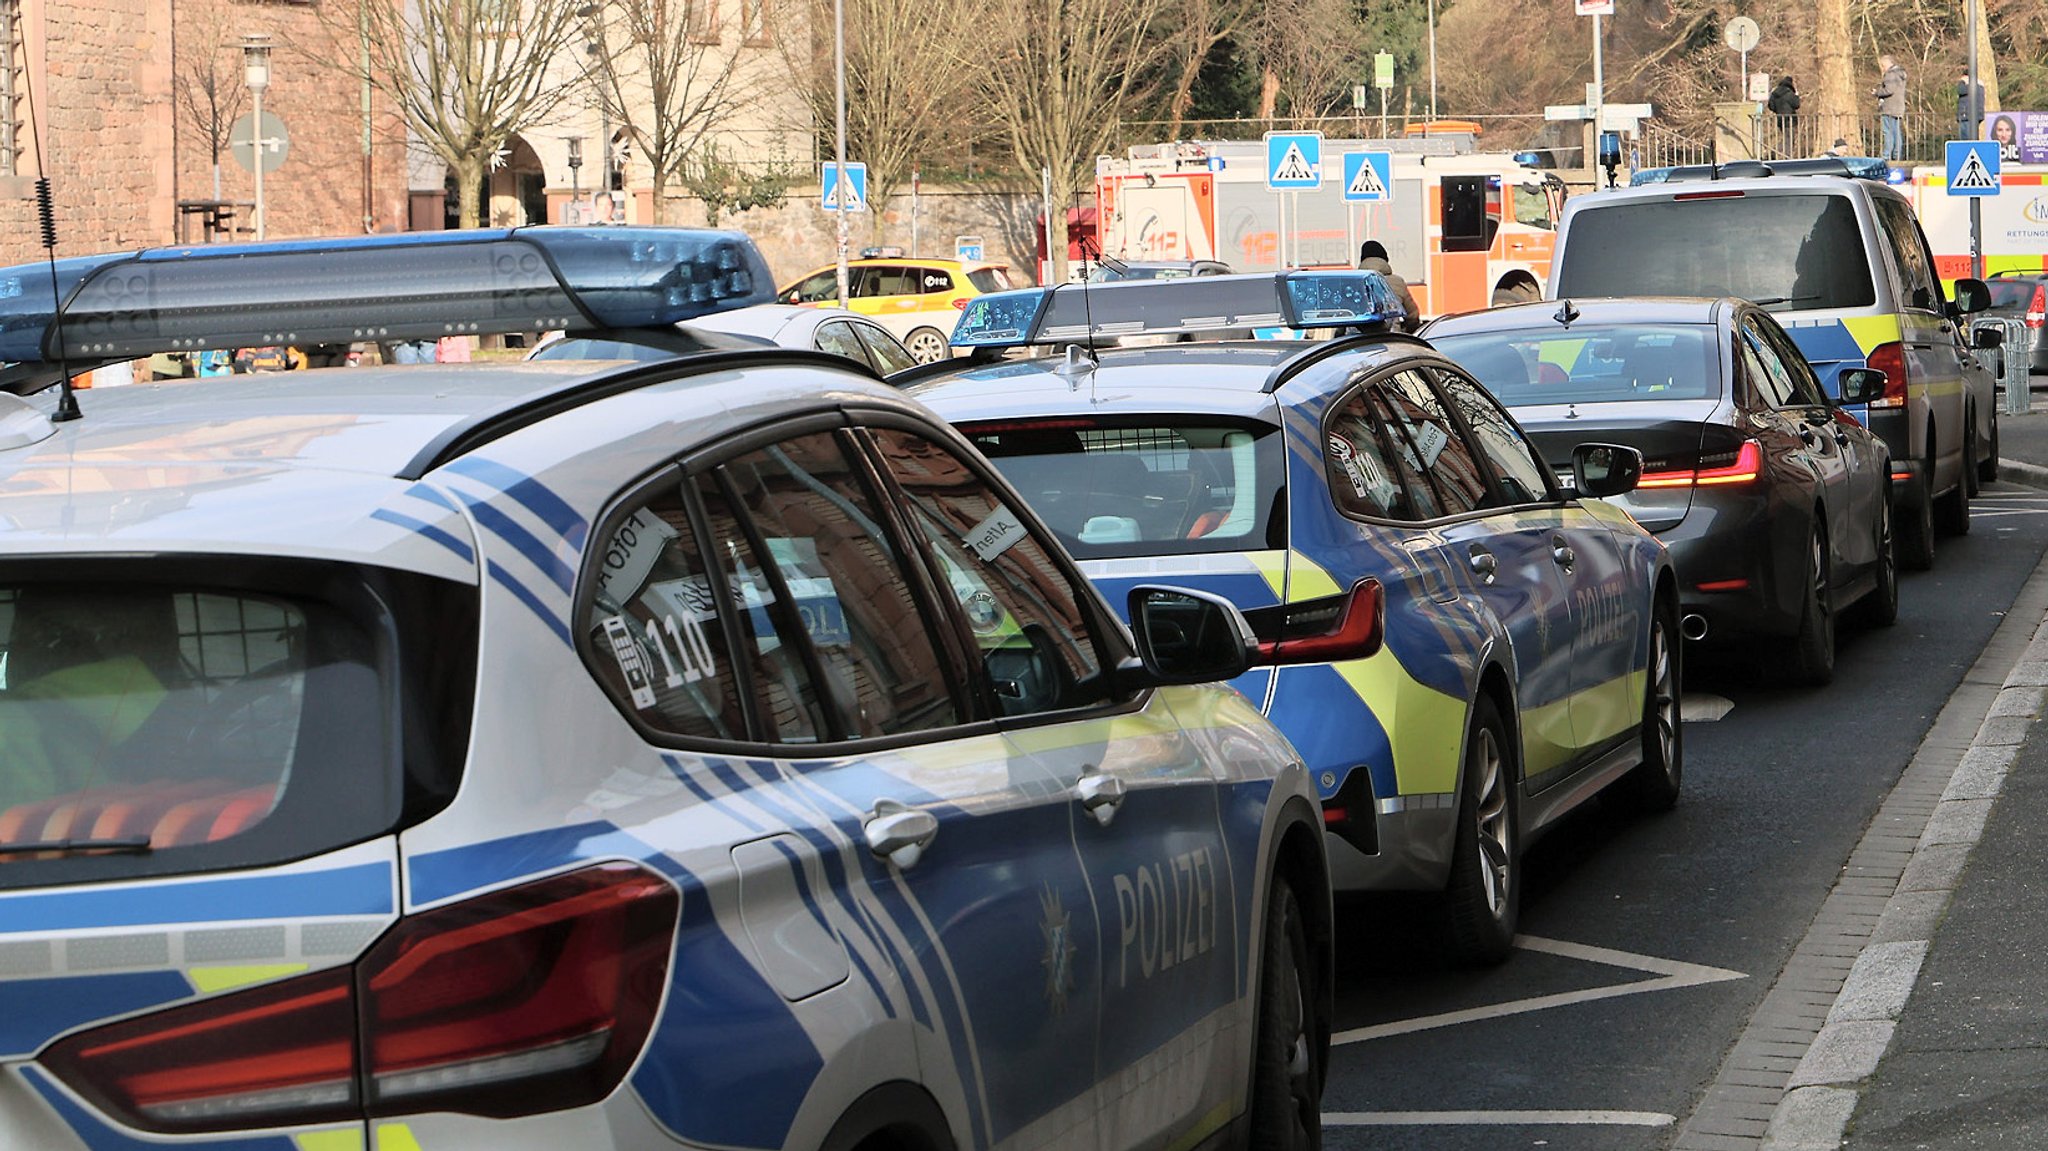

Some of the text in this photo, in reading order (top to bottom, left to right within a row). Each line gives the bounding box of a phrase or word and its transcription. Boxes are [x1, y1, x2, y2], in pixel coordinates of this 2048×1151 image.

[2000, 144, 2020, 159] olt
[1147, 231, 1178, 260] 112
[1241, 231, 1278, 264] 112
[935, 277, 948, 286] 112
[1576, 581, 1623, 649] POLIZEI
[646, 609, 716, 689] 110
[1112, 846, 1216, 988] POLIZEI
